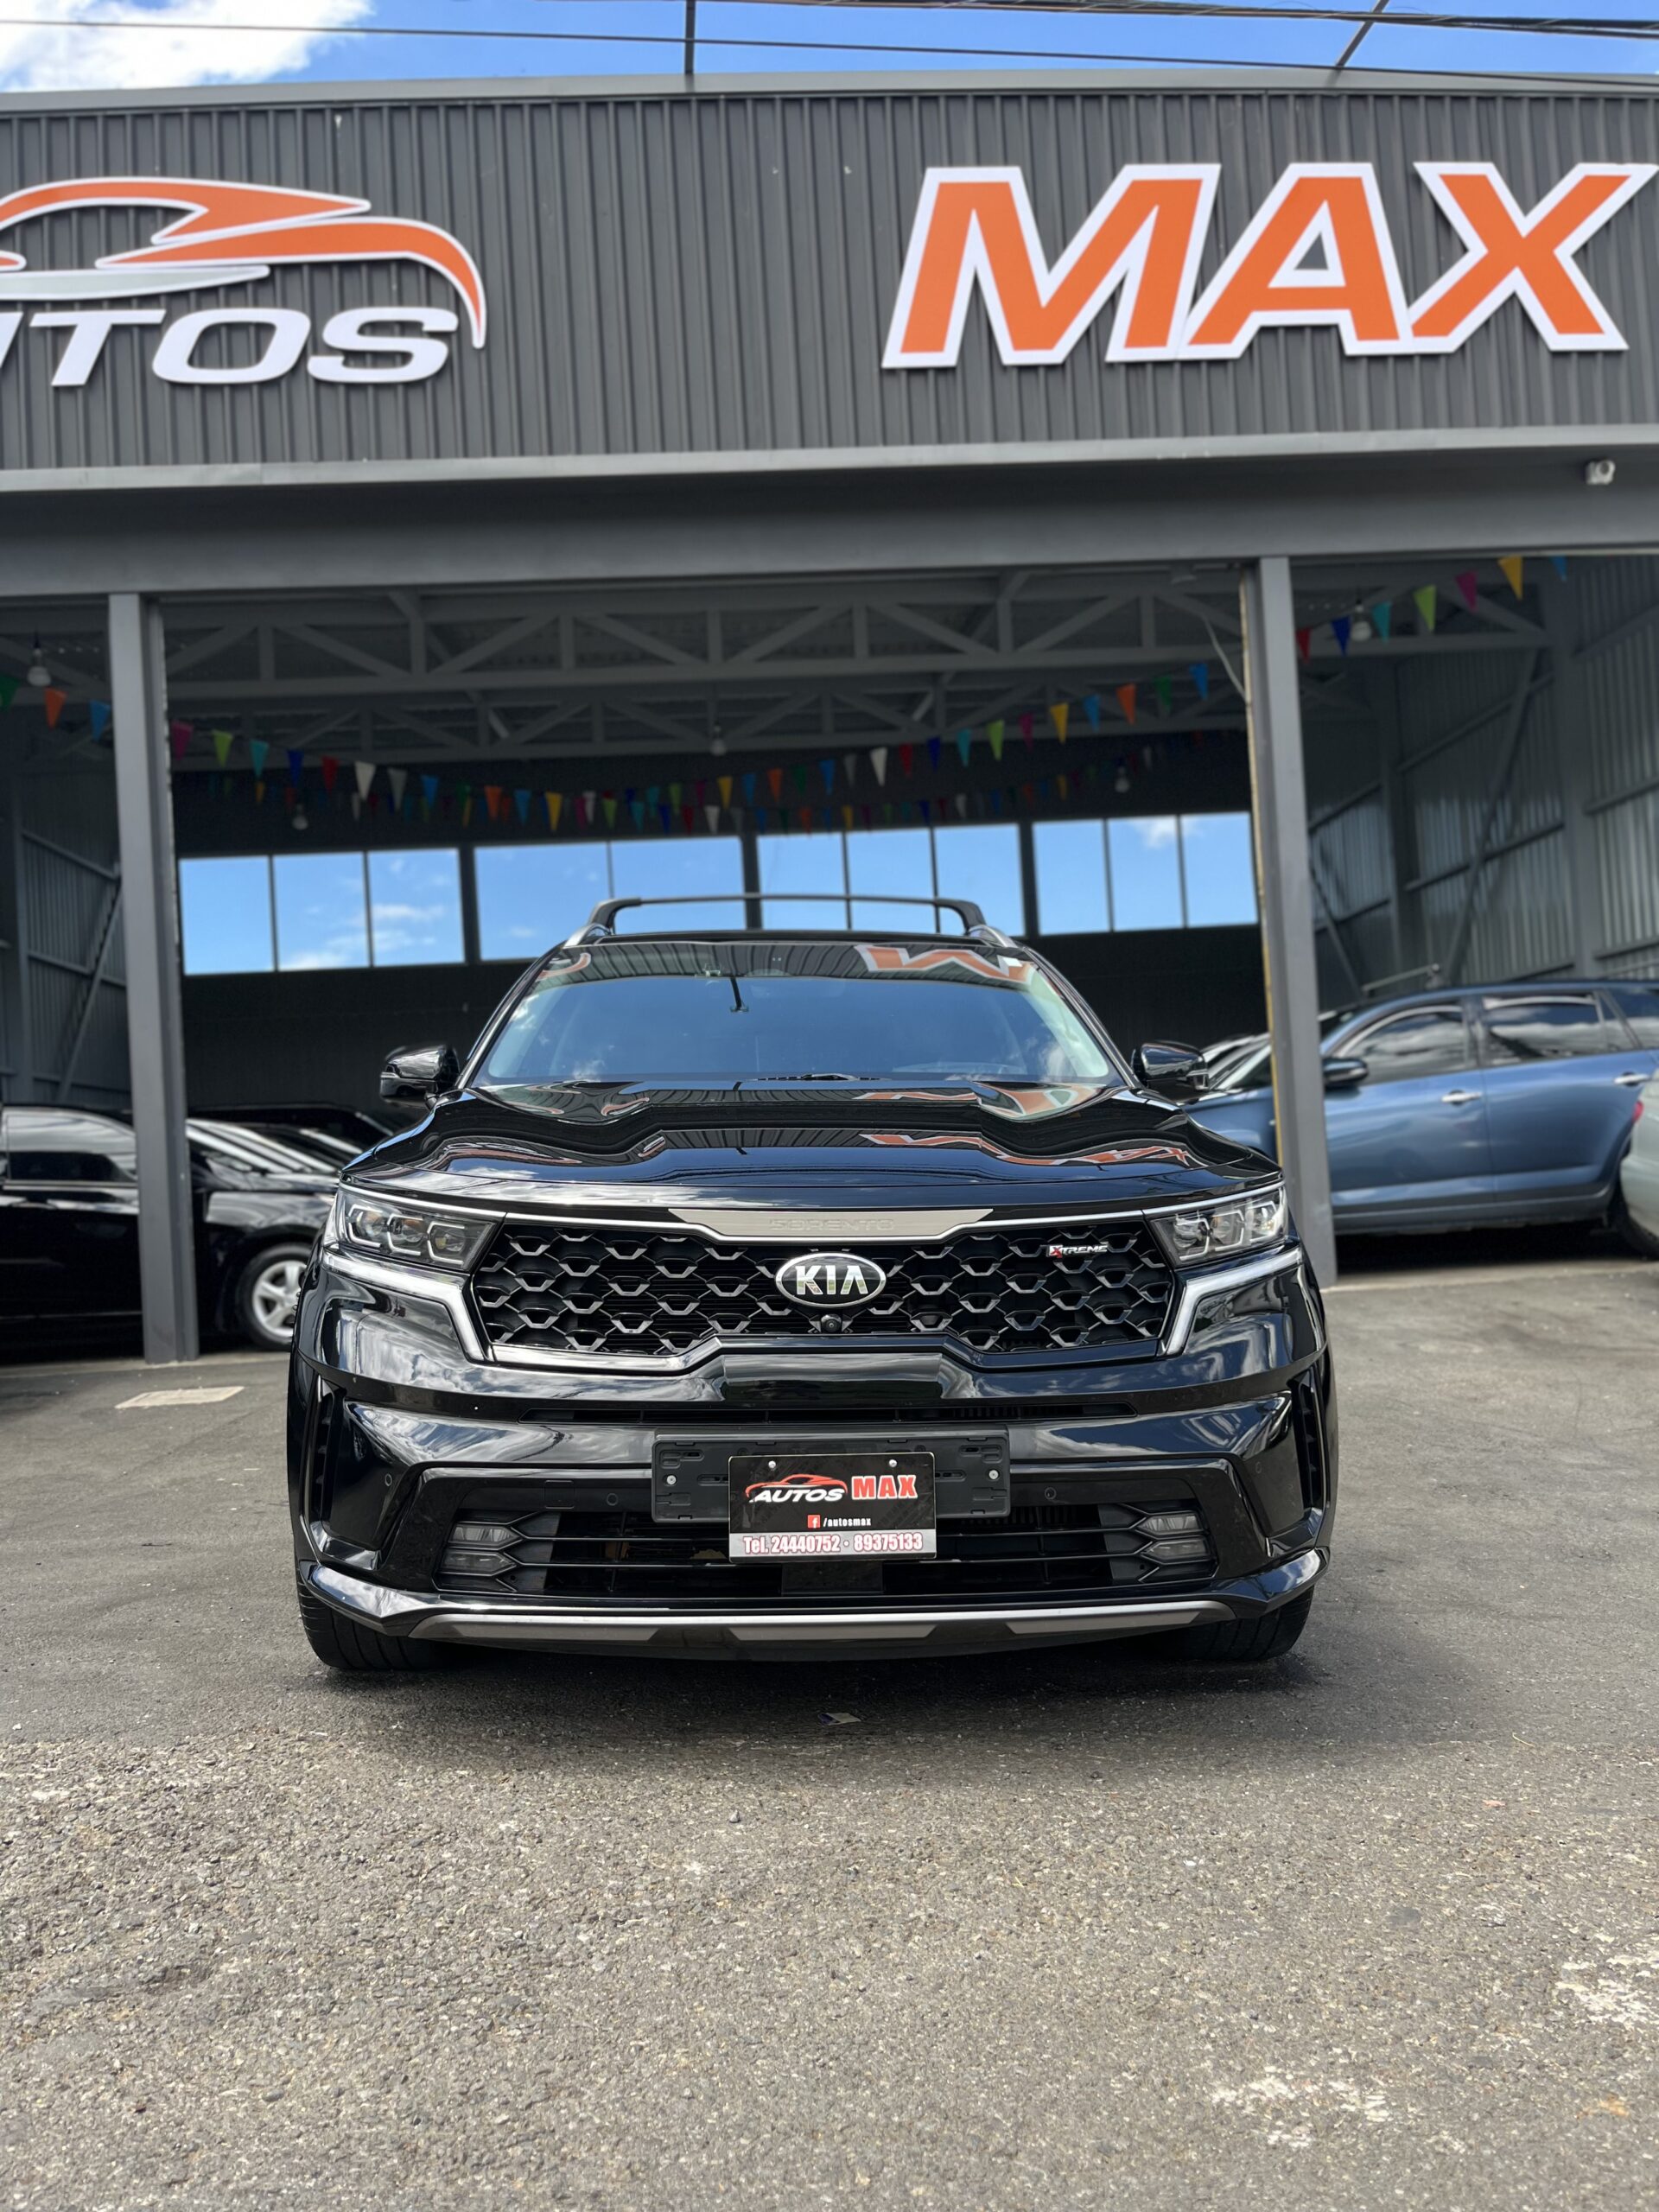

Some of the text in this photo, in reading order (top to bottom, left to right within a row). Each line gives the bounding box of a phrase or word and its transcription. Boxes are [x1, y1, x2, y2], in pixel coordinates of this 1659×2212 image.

[0, 162, 1659, 386] TOS MAX
[769, 1218, 894, 1231] SORENTO
[1048, 1244, 1108, 1258] XTREME
[796, 1265, 869, 1295] KIA
[749, 1475, 918, 1503] AUTOS MAX
[823, 1517, 871, 1527] /autosmax
[743, 1532, 924, 1554] Tel. 24440752 89375133
